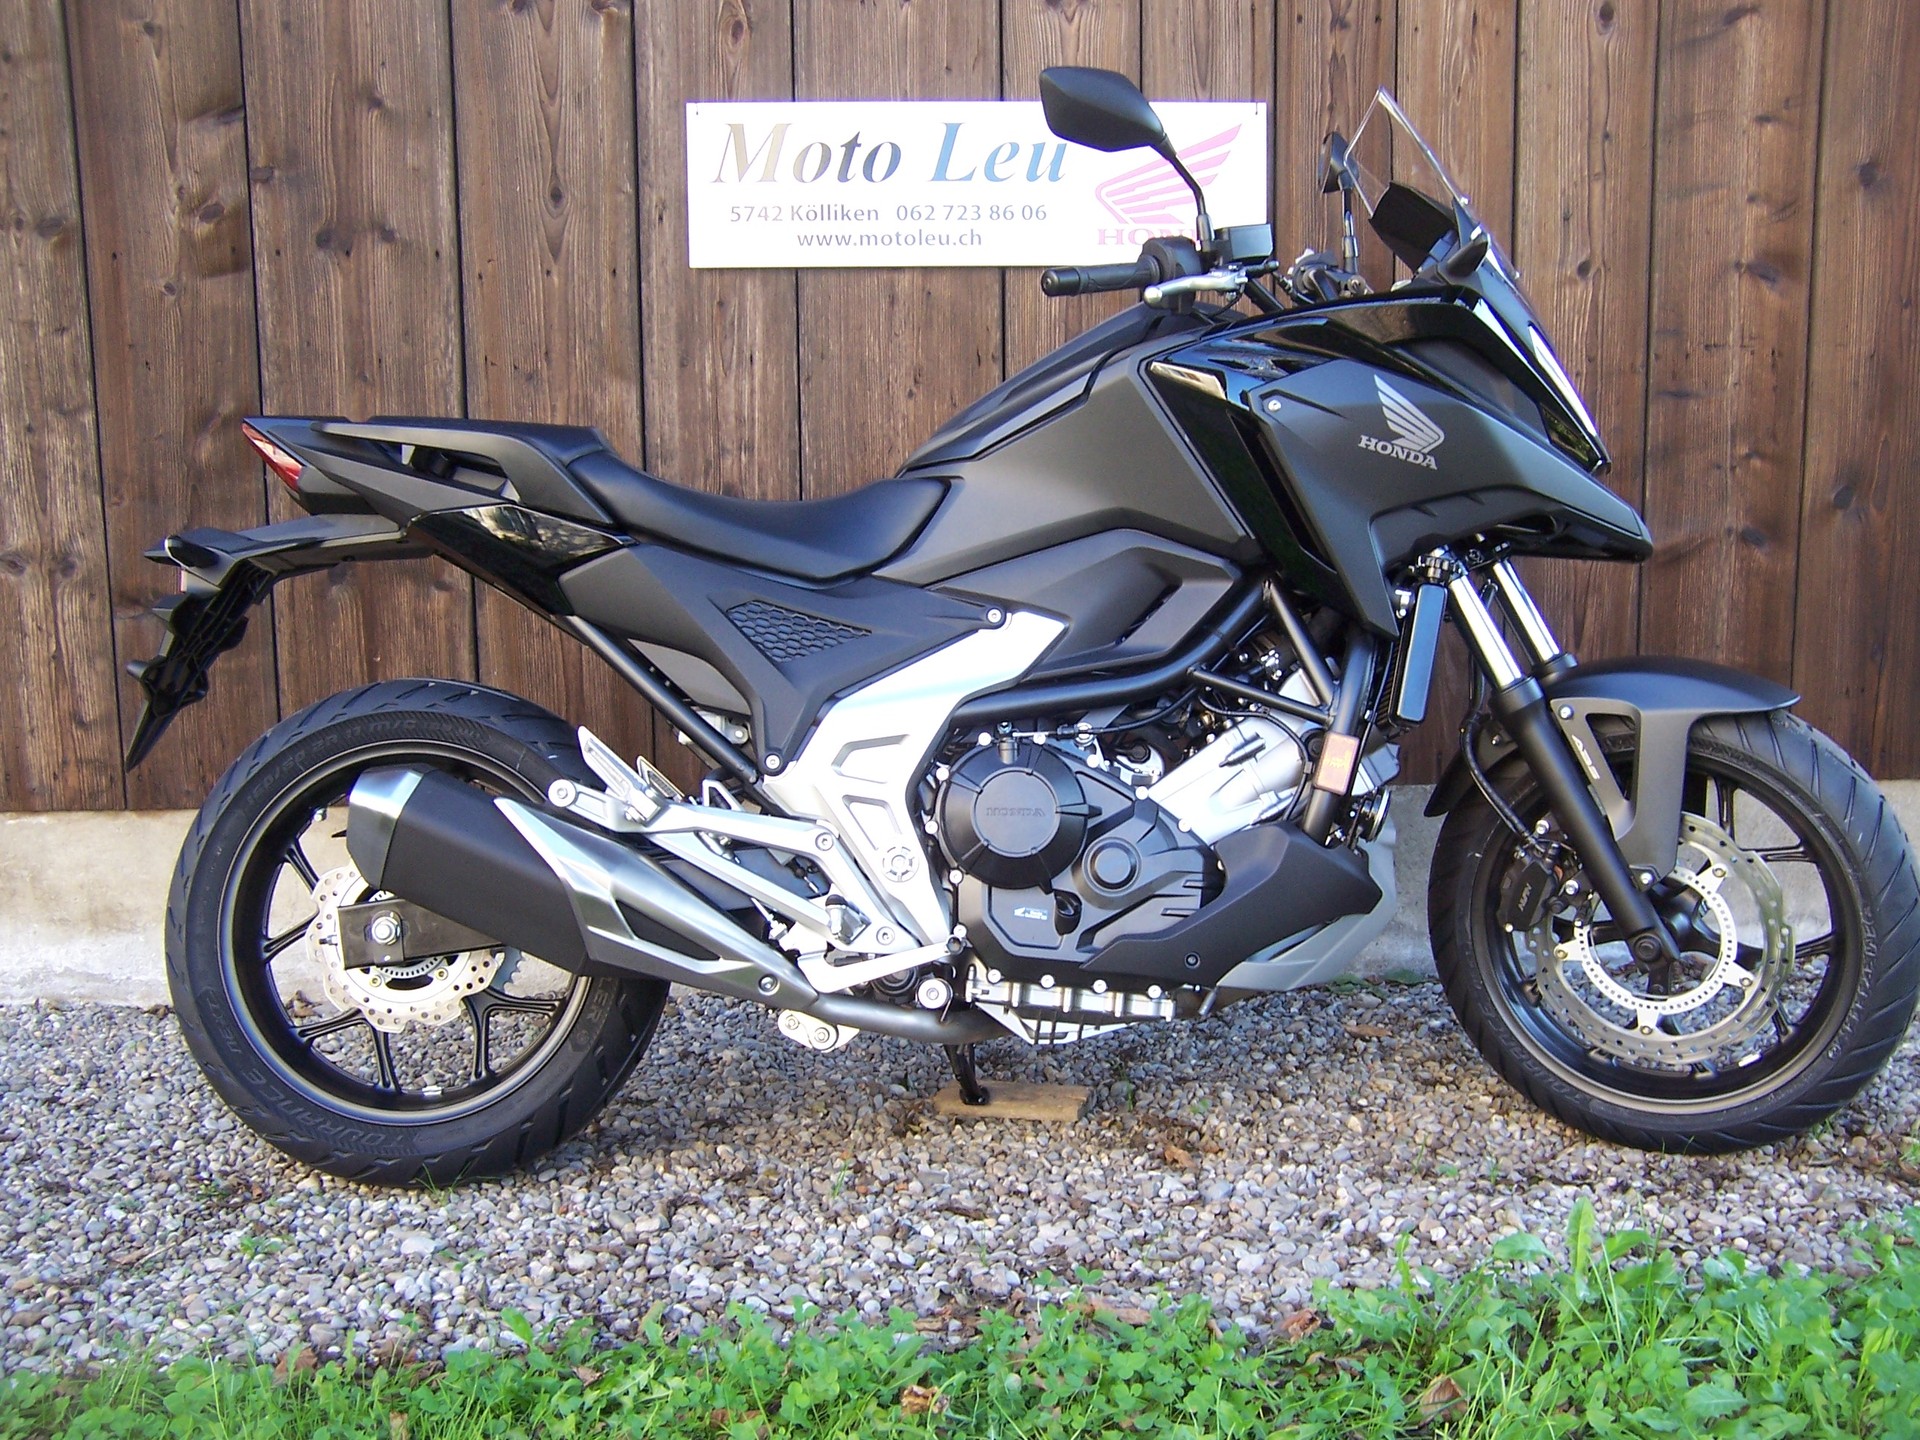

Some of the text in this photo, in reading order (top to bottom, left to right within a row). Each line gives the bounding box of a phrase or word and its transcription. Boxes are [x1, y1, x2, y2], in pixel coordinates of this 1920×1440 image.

[711, 122, 1067, 184] Moto Leu
[730, 203, 1047, 222] 5742 Kölliken 062 723 86 06
[797, 228, 982, 246] www.motoleu.ch
[1357, 434, 1438, 470] HONDA
[985, 806, 1046, 817] HONDA
[241, 1067, 405, 1150] TOURANCE
